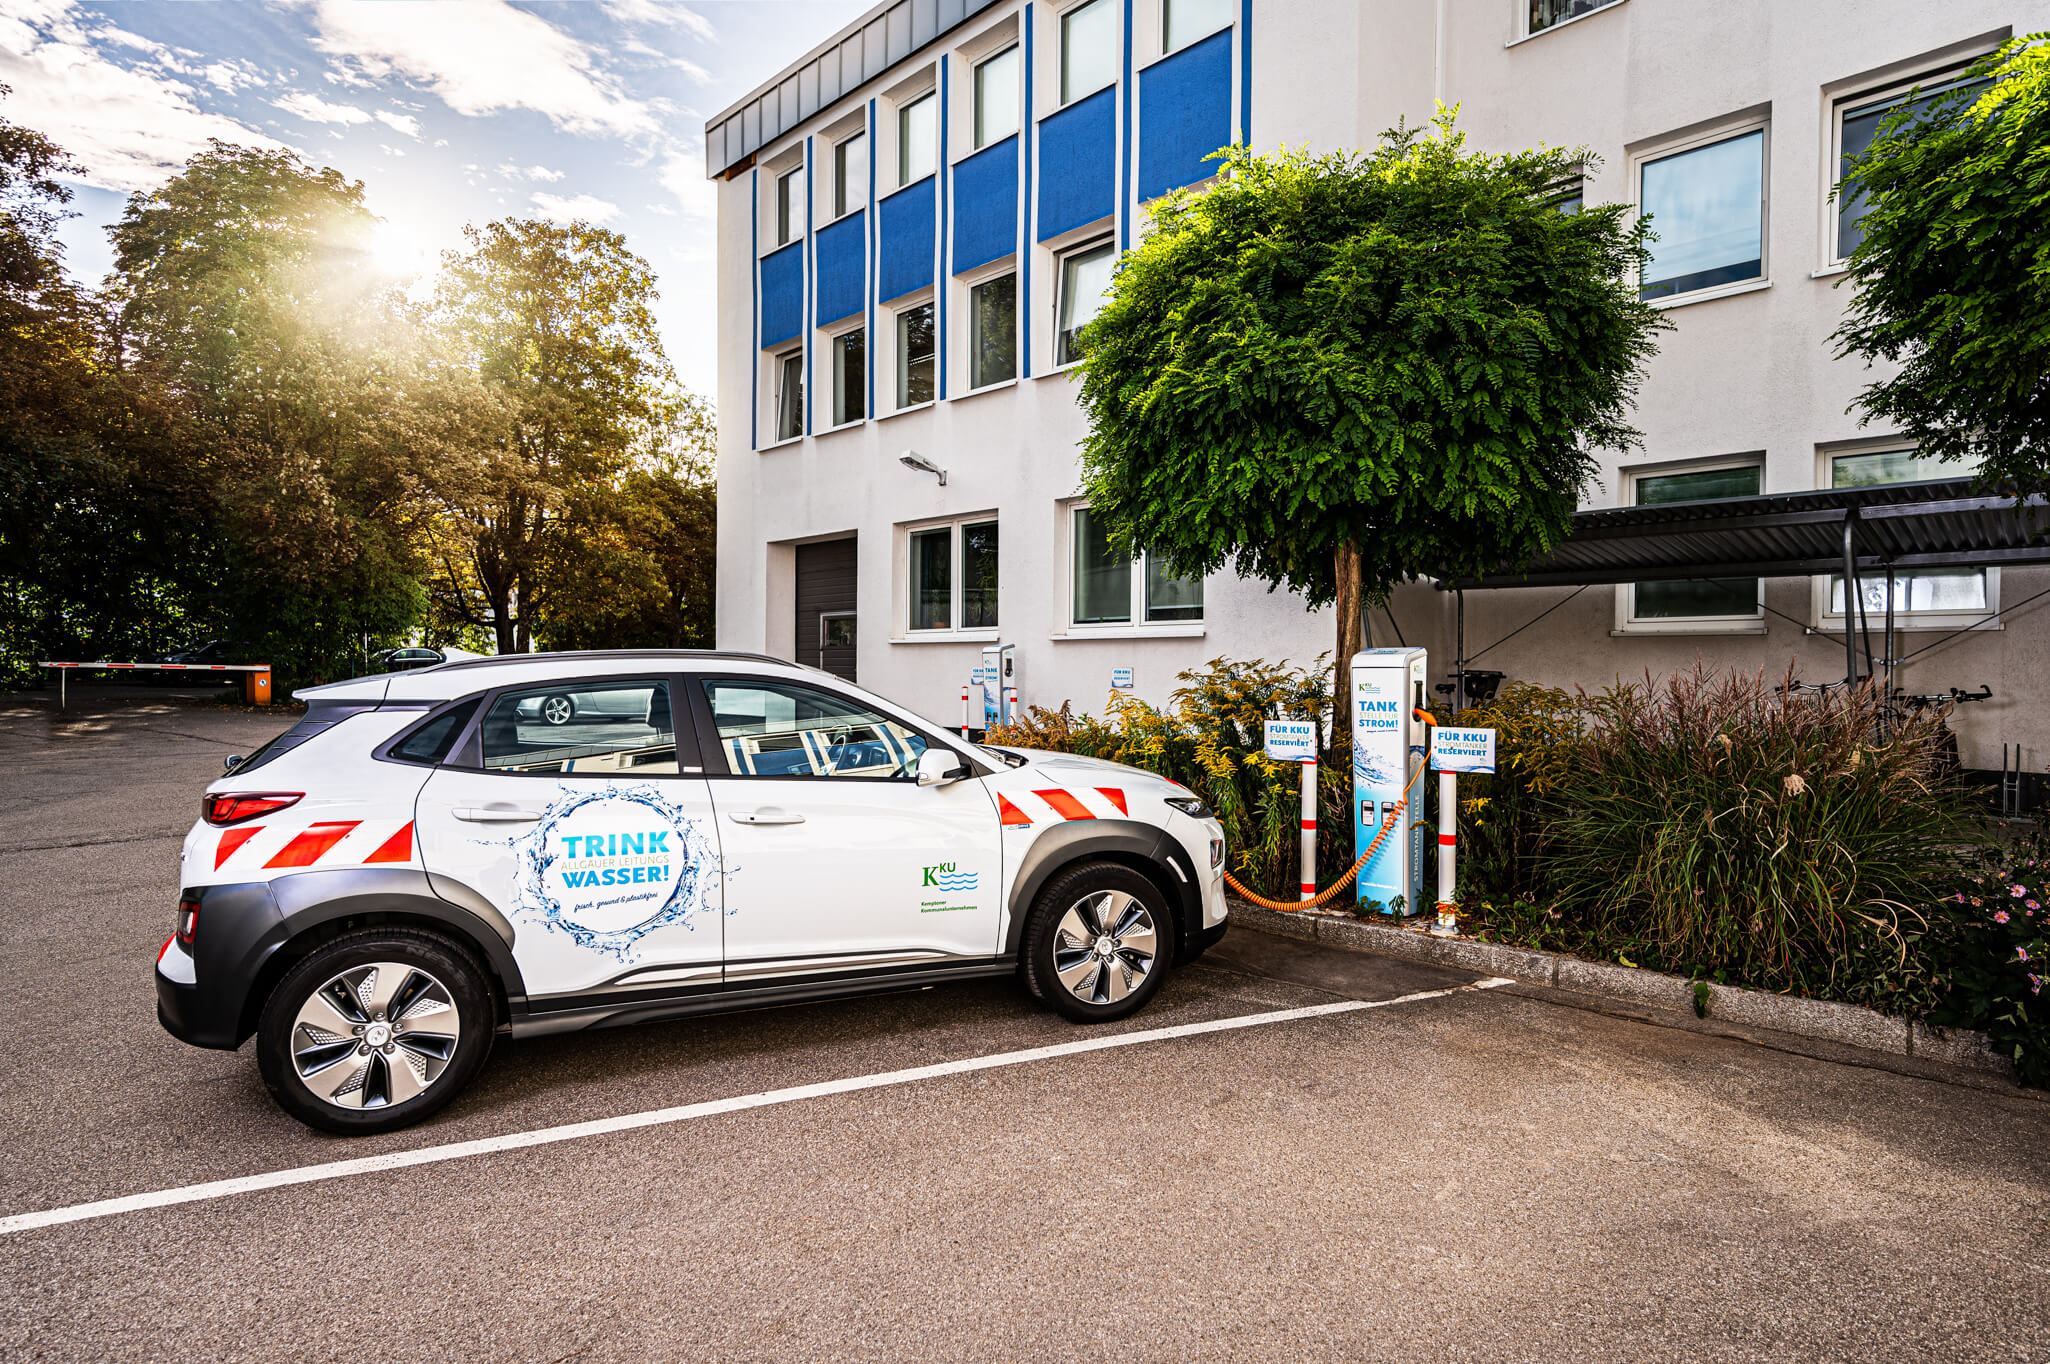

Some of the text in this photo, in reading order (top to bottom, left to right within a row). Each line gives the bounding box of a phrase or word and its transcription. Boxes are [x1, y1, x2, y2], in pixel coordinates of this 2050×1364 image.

[1358, 700, 1398, 712] TANK
[1270, 724, 1288, 733] FÜR
[1358, 719, 1398, 728] STROM!
[1438, 730, 1488, 742] FÜR KKU
[1438, 748, 1487, 756] RESERVIERT
[561, 831, 670, 859] TRINK
[619, 854, 670, 866] LEITUNGS
[561, 864, 669, 888] WASSER!
[596, 897, 620, 910] gesund
